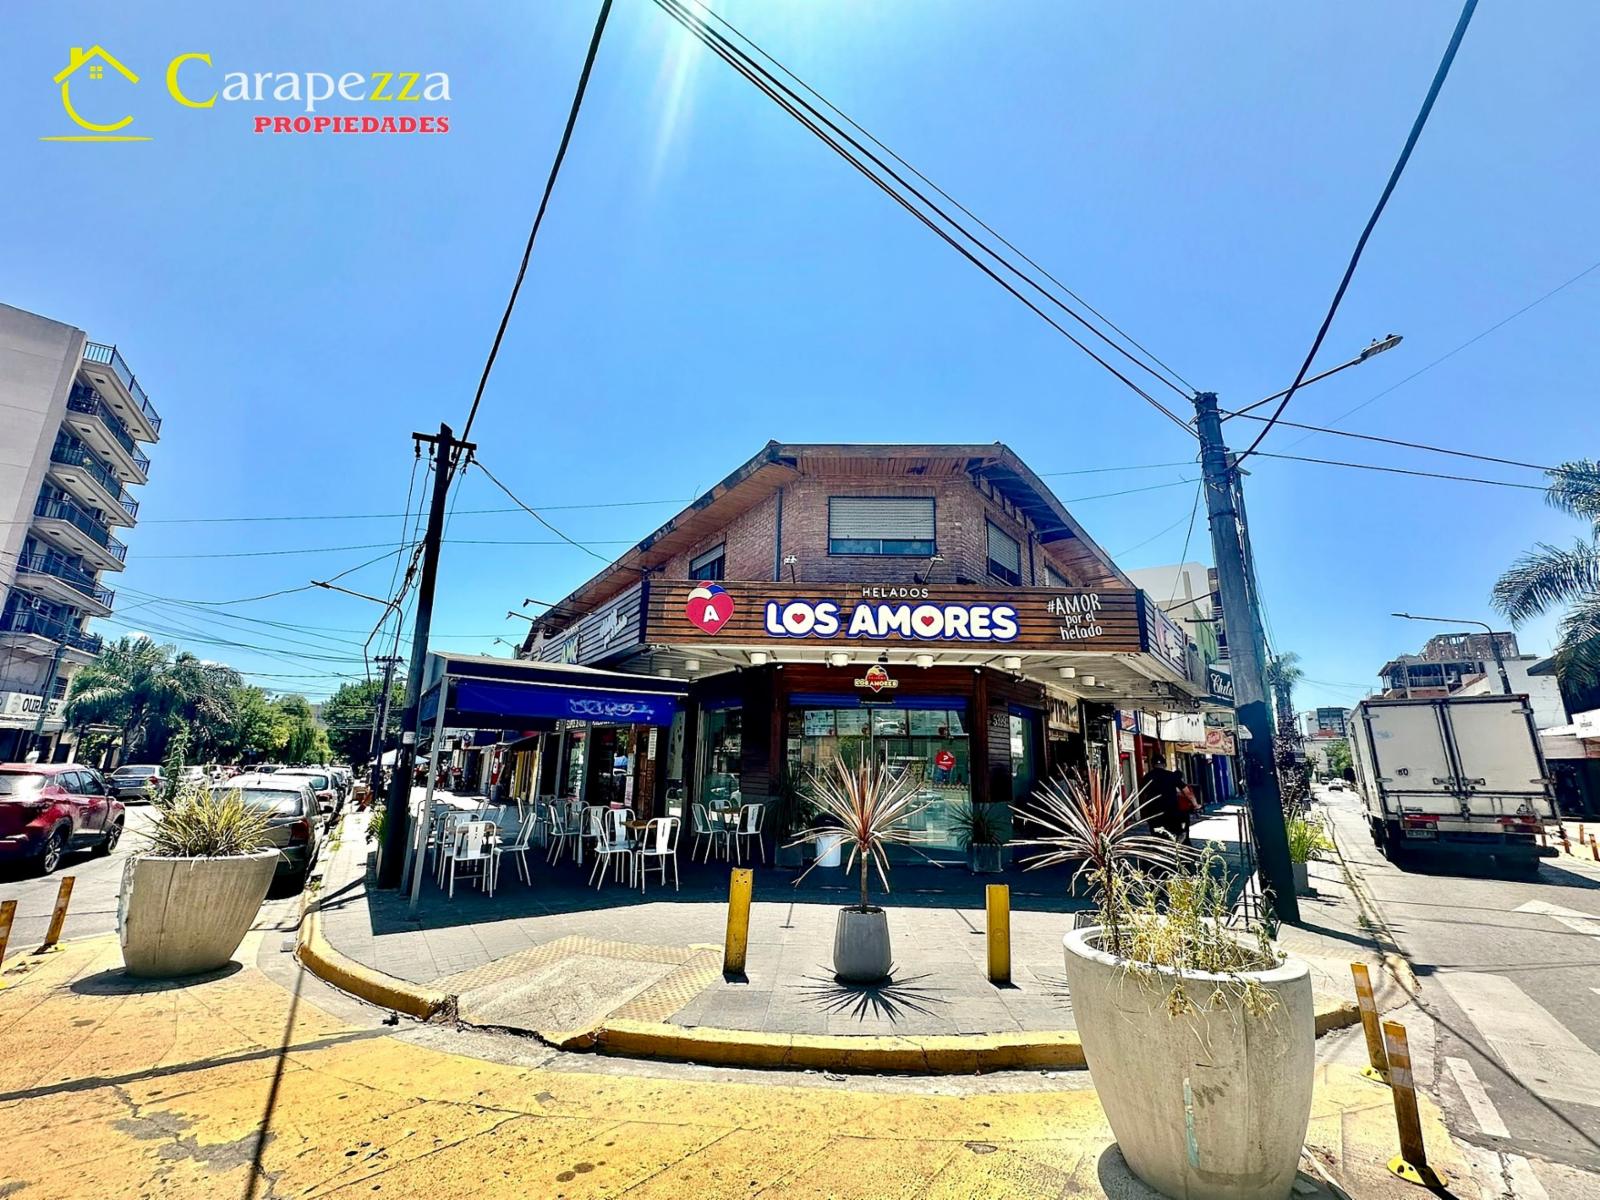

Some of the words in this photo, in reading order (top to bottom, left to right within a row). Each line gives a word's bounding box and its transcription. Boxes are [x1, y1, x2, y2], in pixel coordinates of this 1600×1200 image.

[862, 587, 929, 599] HELADOS
[1047, 593, 1101, 616] #AMOR
[703, 605, 720, 623] A
[764, 600, 841, 637] LOS
[847, 601, 1019, 642] AMORES
[1065, 614, 1082, 629] por
[1085, 609, 1096, 622] el
[1060, 622, 1103, 640] helado
[22, 698, 59, 716] OURSE
